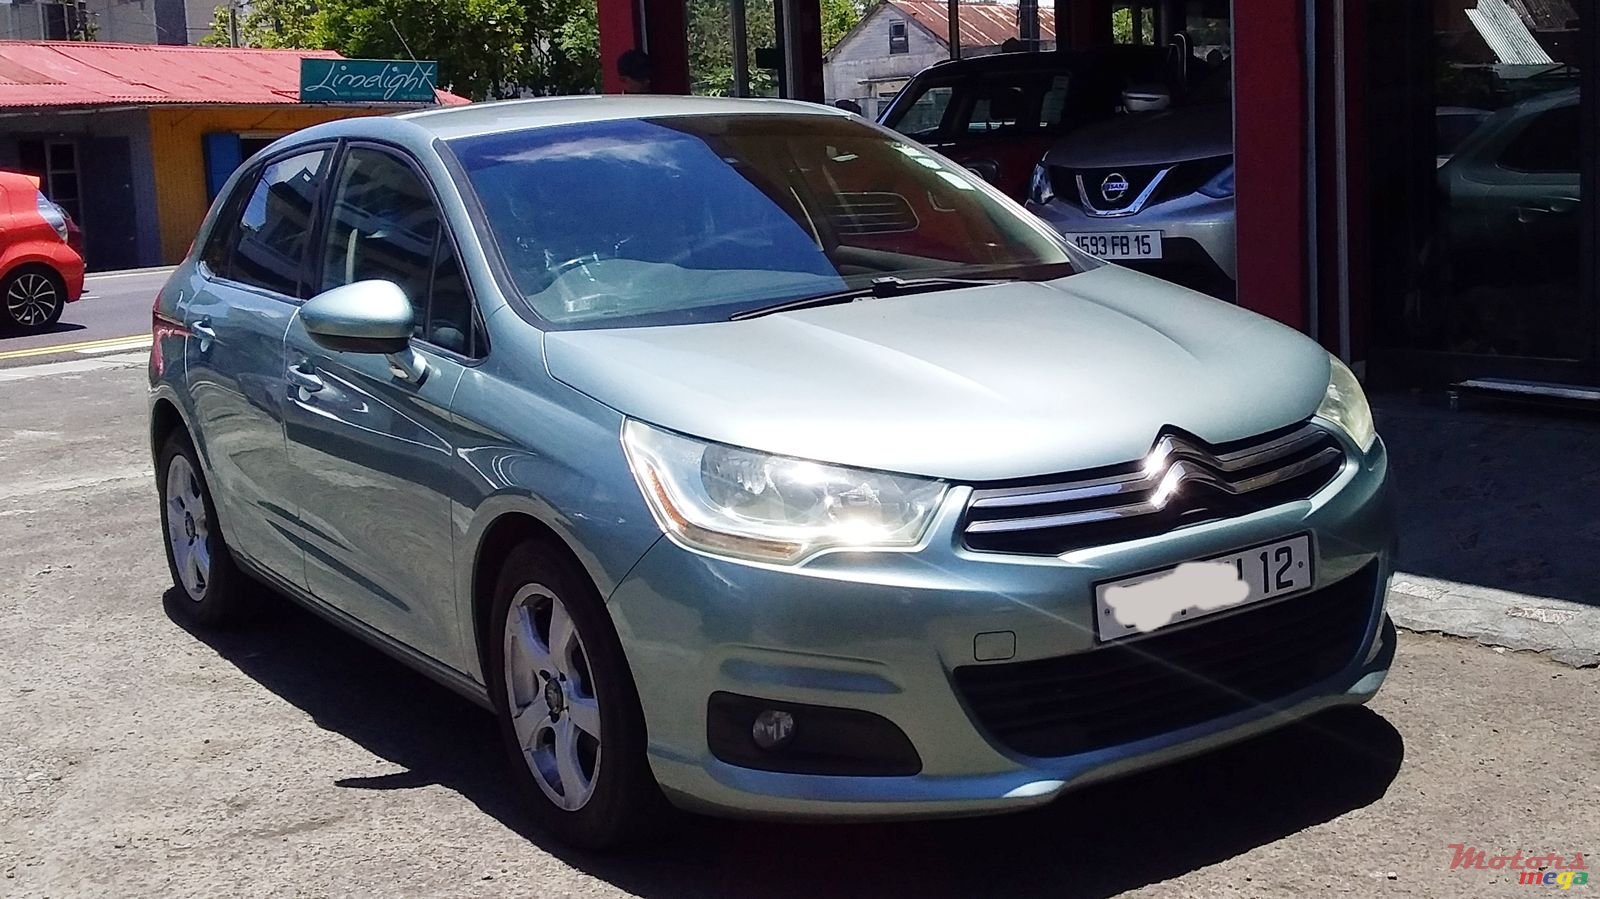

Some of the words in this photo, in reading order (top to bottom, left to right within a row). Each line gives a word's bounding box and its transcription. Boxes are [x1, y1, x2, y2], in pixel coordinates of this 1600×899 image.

[304, 62, 434, 100] Limelight
[1076, 235, 1107, 255] 1593
[1111, 235, 1130, 255] FB
[1134, 235, 1151, 255] 15
[1260, 546, 1294, 593] 12
